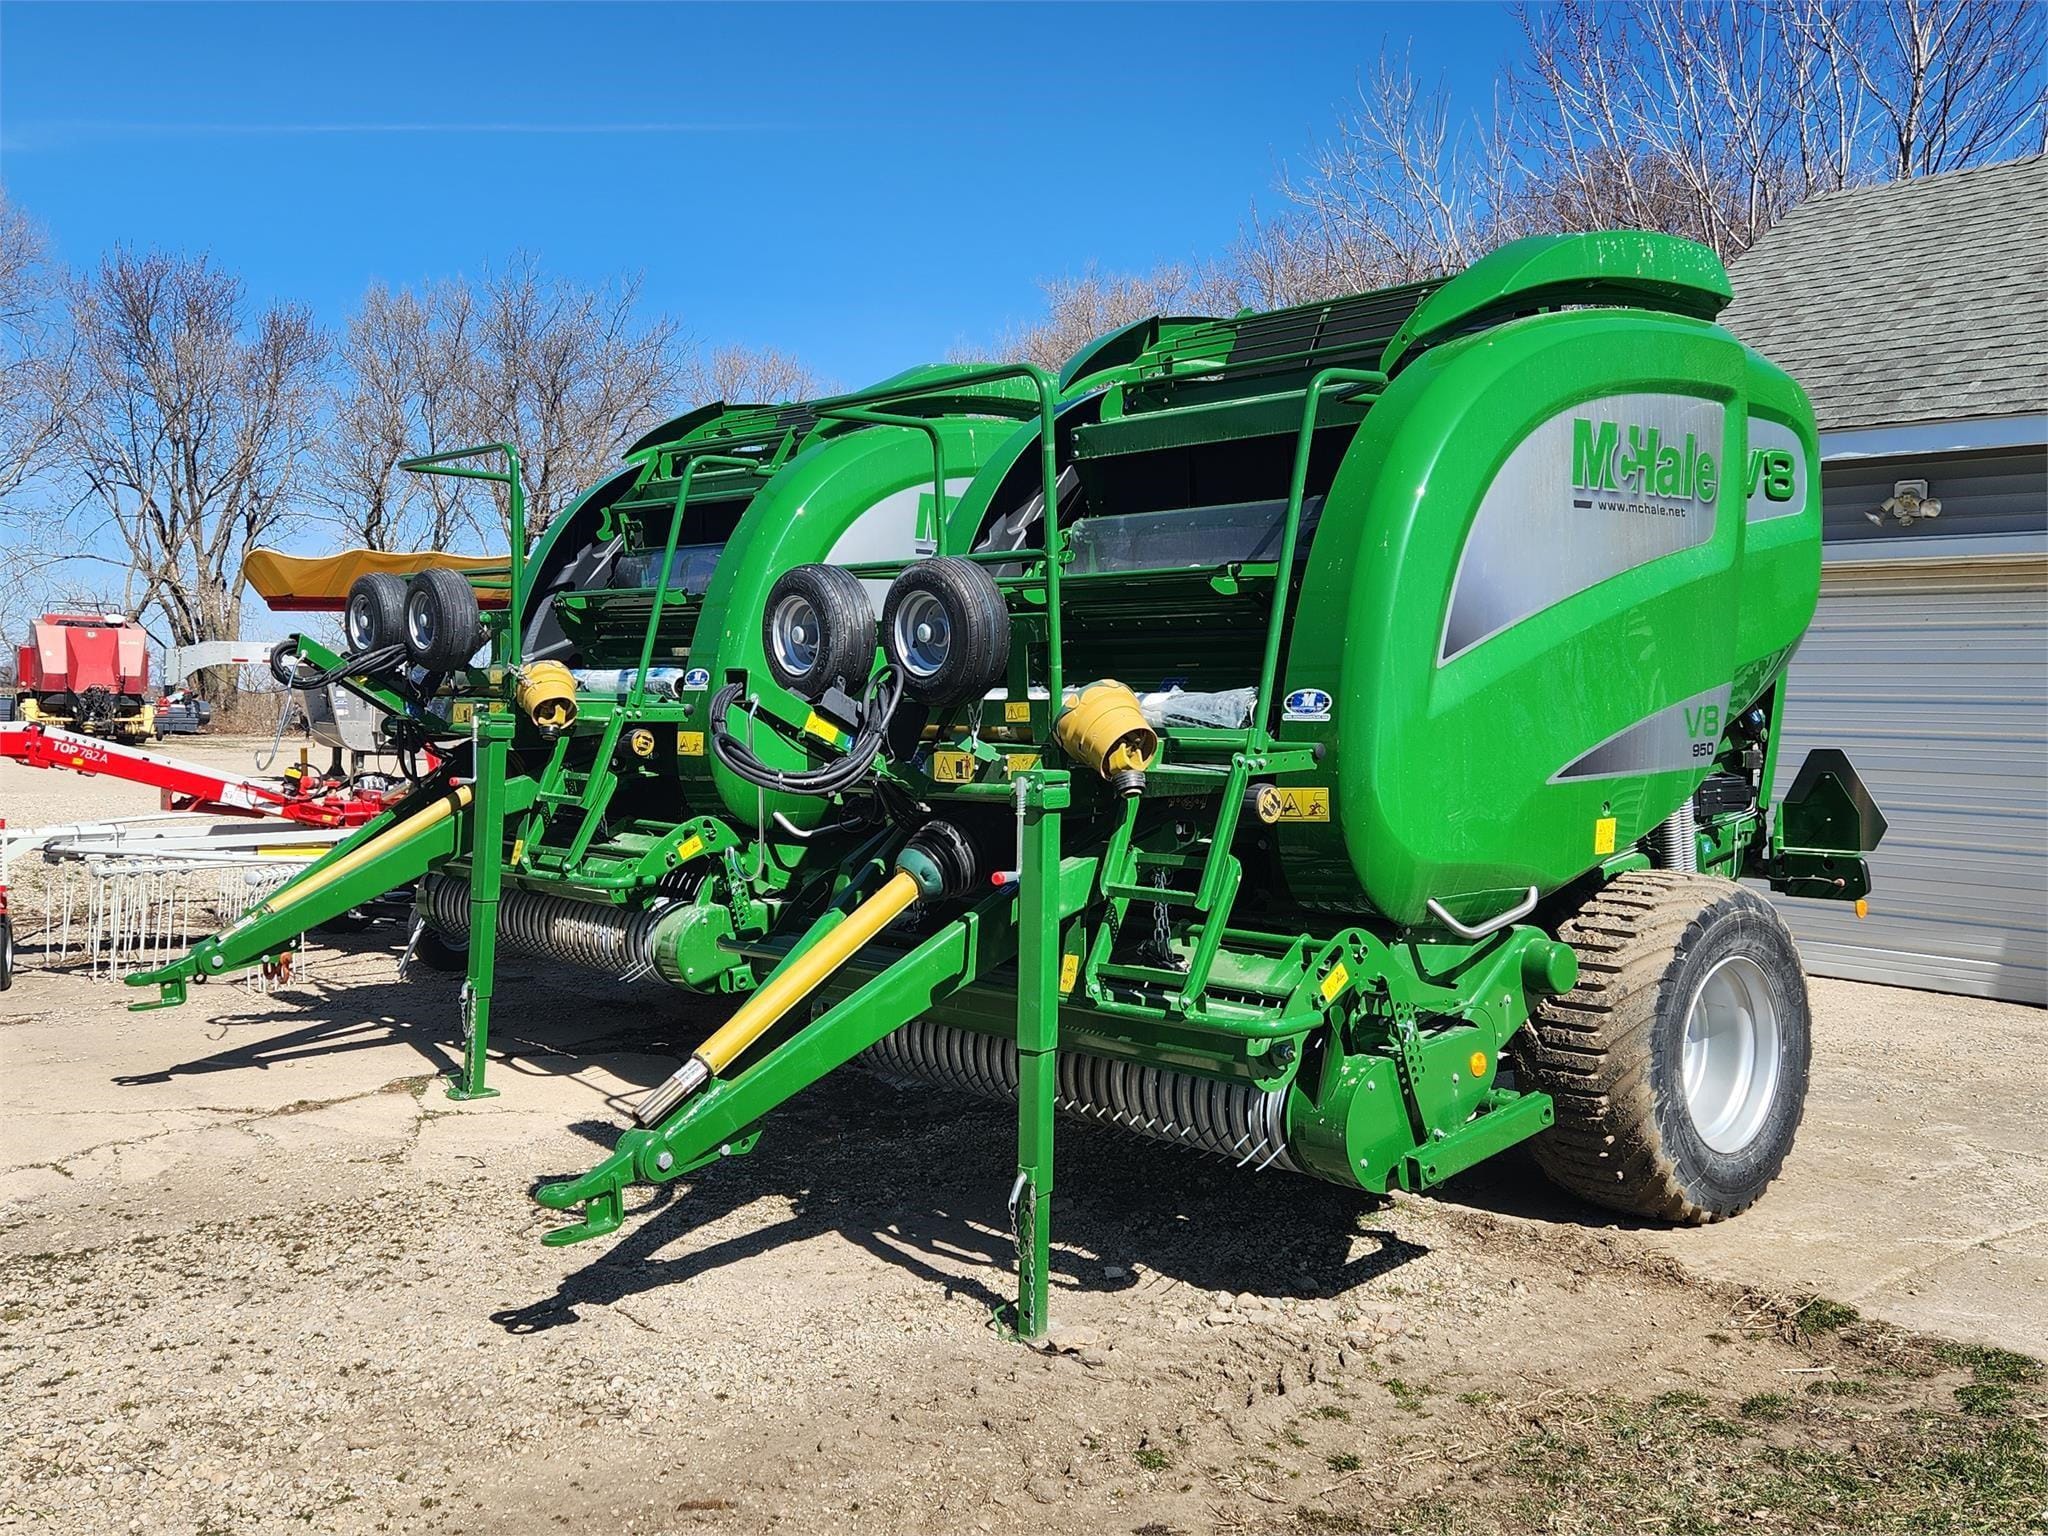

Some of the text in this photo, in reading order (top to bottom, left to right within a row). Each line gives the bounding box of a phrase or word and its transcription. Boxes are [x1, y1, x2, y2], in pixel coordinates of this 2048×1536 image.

[1572, 418, 1717, 503] McHale
[1598, 501, 1686, 517] www.mchale.net
[1684, 705, 1719, 738] V8
[53, 741, 79, 755] TOP
[1692, 742, 1714, 757] 950
